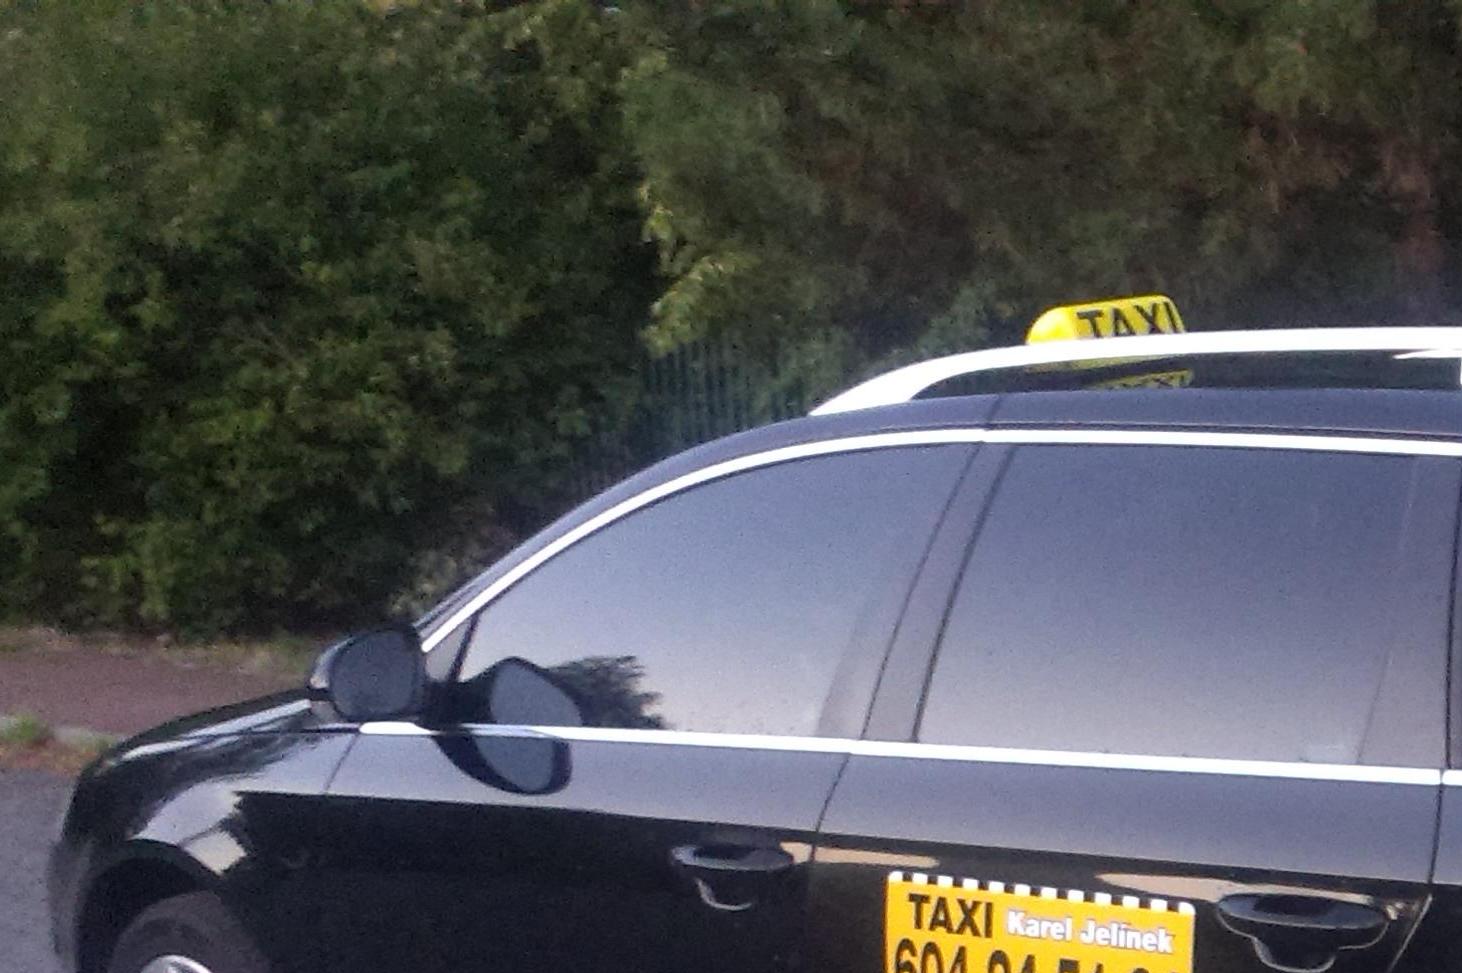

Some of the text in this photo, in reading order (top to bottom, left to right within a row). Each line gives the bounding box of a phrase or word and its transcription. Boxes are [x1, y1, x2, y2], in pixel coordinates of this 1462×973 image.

[1077, 301, 1180, 339] TAXI
[908, 893, 993, 938] TAXI
[1006, 908, 1073, 940] Karel
